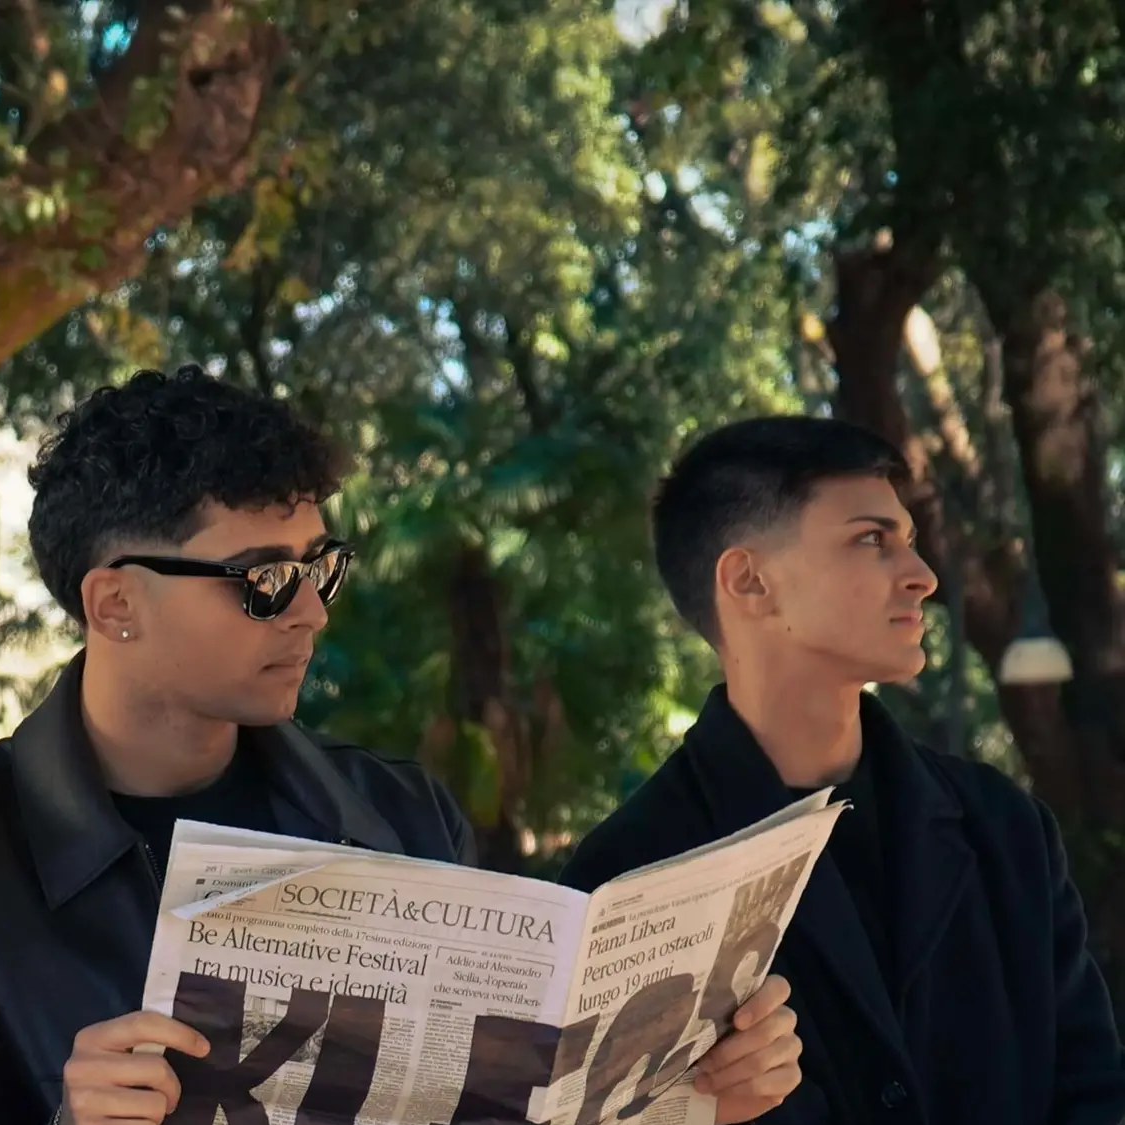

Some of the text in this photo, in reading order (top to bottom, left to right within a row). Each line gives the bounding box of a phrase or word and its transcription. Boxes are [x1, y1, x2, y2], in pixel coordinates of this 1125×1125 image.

[232, 914, 285, 929] programma
[285, 922, 331, 936] completo
[331, 927, 354, 939] della
[355, 931, 392, 945] 17esima
[392, 938, 433, 951] edizione
[280, 883, 555, 944] SOCIETÀ&CULTURA
[187, 920, 429, 977] Be Alternative Festival
[581, 950, 645, 987] Percorso
[647, 946, 656, 962] a
[659, 921, 715, 957] ostacoli
[587, 931, 627, 960] Piana
[630, 916, 676, 944] Libera
[195, 957, 221, 979] tra
[226, 964, 303, 992] musica
[309, 975, 323, 992] e
[328, 973, 408, 1005] identità
[445, 955, 542, 979] Addio ad Alessandro
[452, 970, 482, 986] Sicilia,
[577, 960, 675, 1015] lungo 19 anni
[433, 982, 452, 995] che
[452, 986, 490, 999] scriveva
[491, 993, 514, 1004] versi
